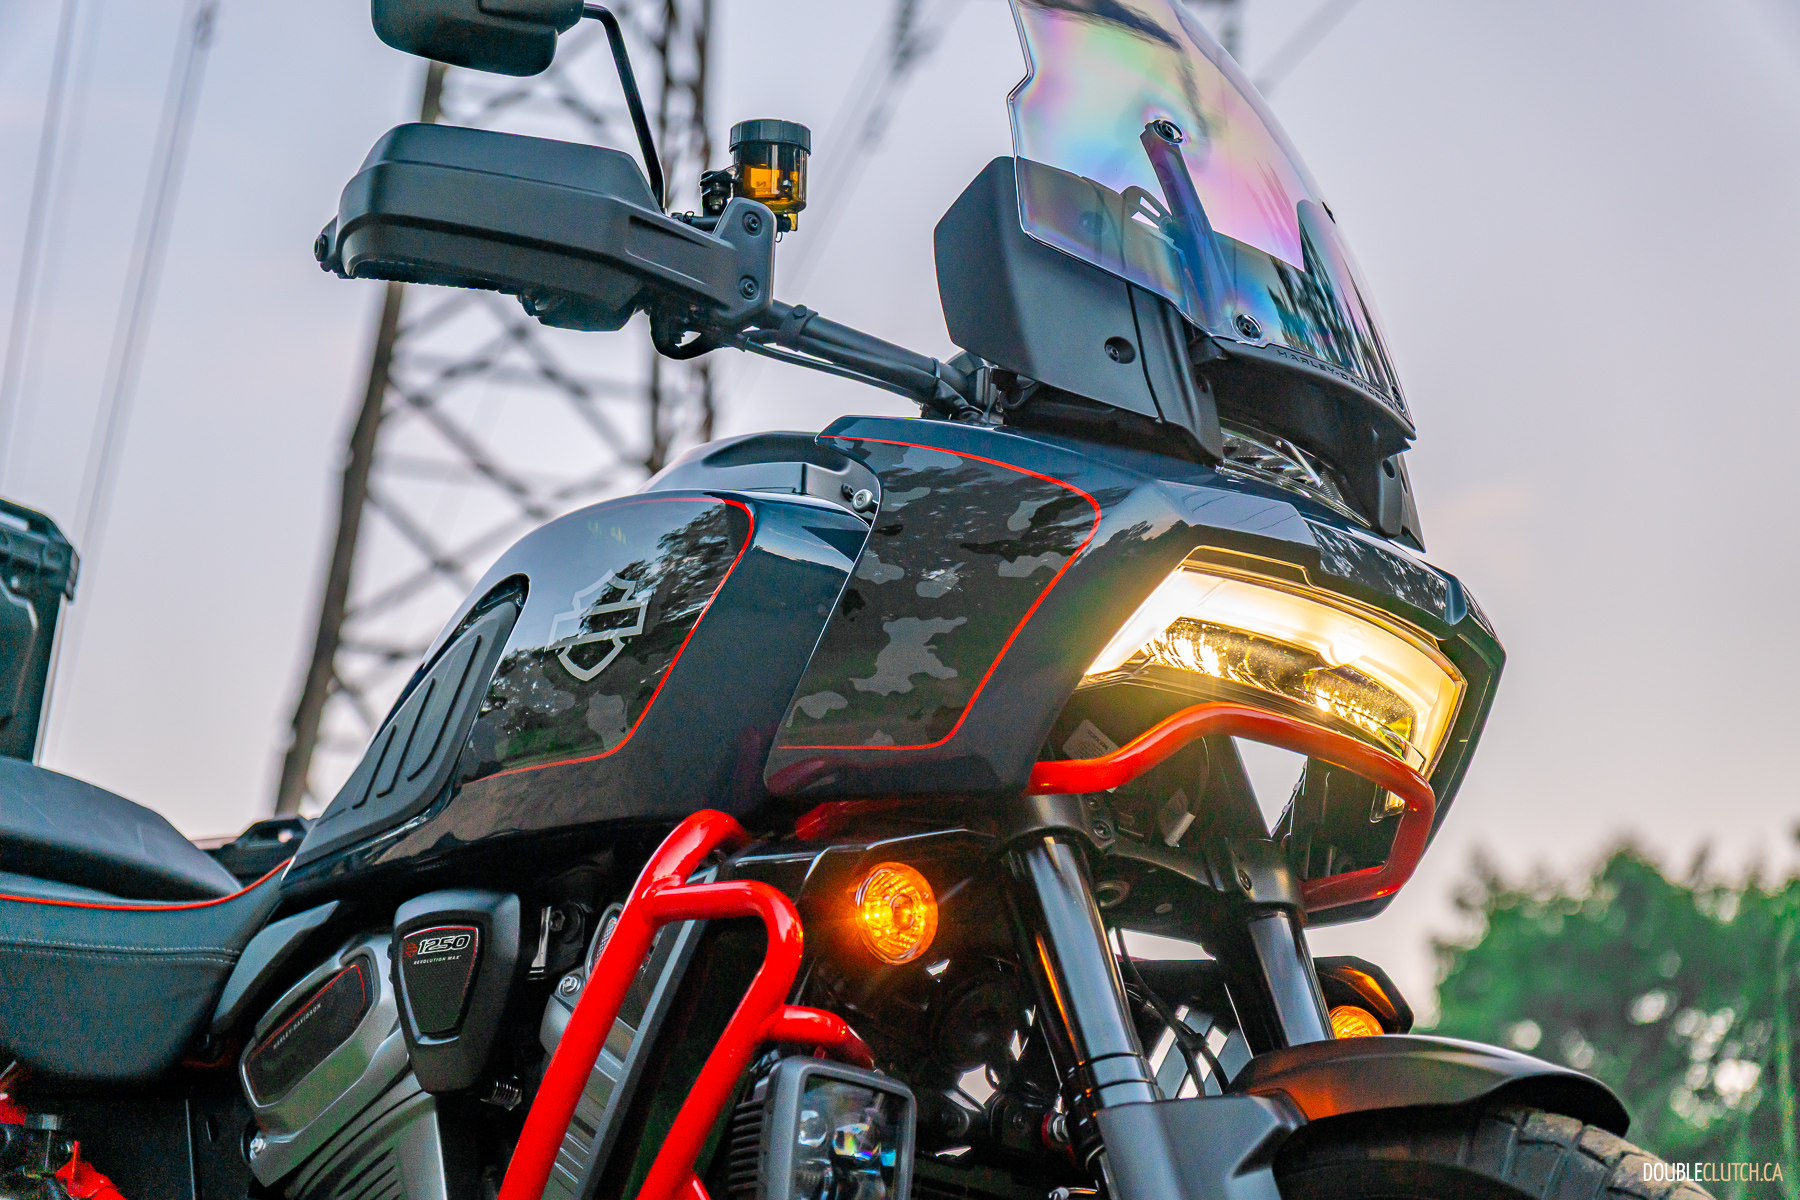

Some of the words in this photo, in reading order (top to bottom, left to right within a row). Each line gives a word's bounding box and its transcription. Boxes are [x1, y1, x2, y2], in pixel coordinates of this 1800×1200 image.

[1276, 349, 1395, 411] HARLEY-DAVIDSON
[413, 956, 447, 965] REVOLUTION
[417, 934, 471, 955] 1250
[273, 1002, 321, 1050] HARLEY-DAVIDSON
